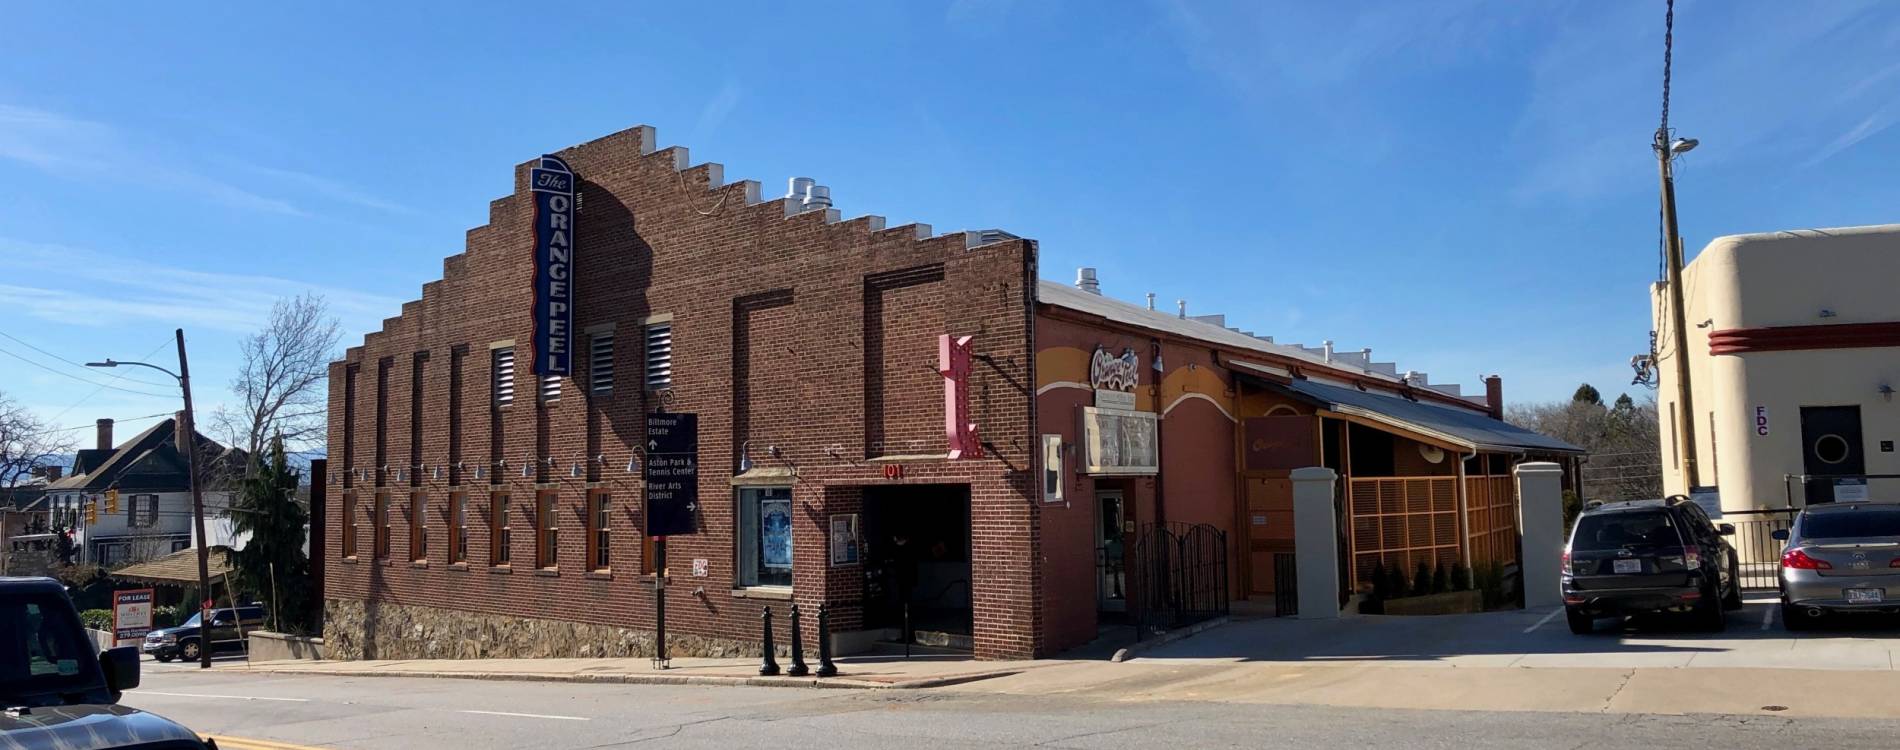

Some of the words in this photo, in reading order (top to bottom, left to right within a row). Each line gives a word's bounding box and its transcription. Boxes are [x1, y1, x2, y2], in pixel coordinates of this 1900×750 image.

[537, 173, 567, 189] The
[548, 195, 570, 298] ORANGE
[548, 301, 567, 371] PEEL
[1091, 350, 1122, 389] Orange
[648, 418, 677, 426] Biltmore
[1756, 406, 1768, 436] FDC
[648, 427, 669, 435] Estate
[648, 458, 668, 467] Aston
[670, 458, 685, 466] Park
[648, 467, 670, 476] Tennis
[672, 467, 695, 475] Center
[883, 463, 900, 477] 101
[648, 482, 666, 490] River
[668, 481, 682, 490] Arts
[648, 491, 673, 500] District
[132, 593, 150, 601] LEASE
